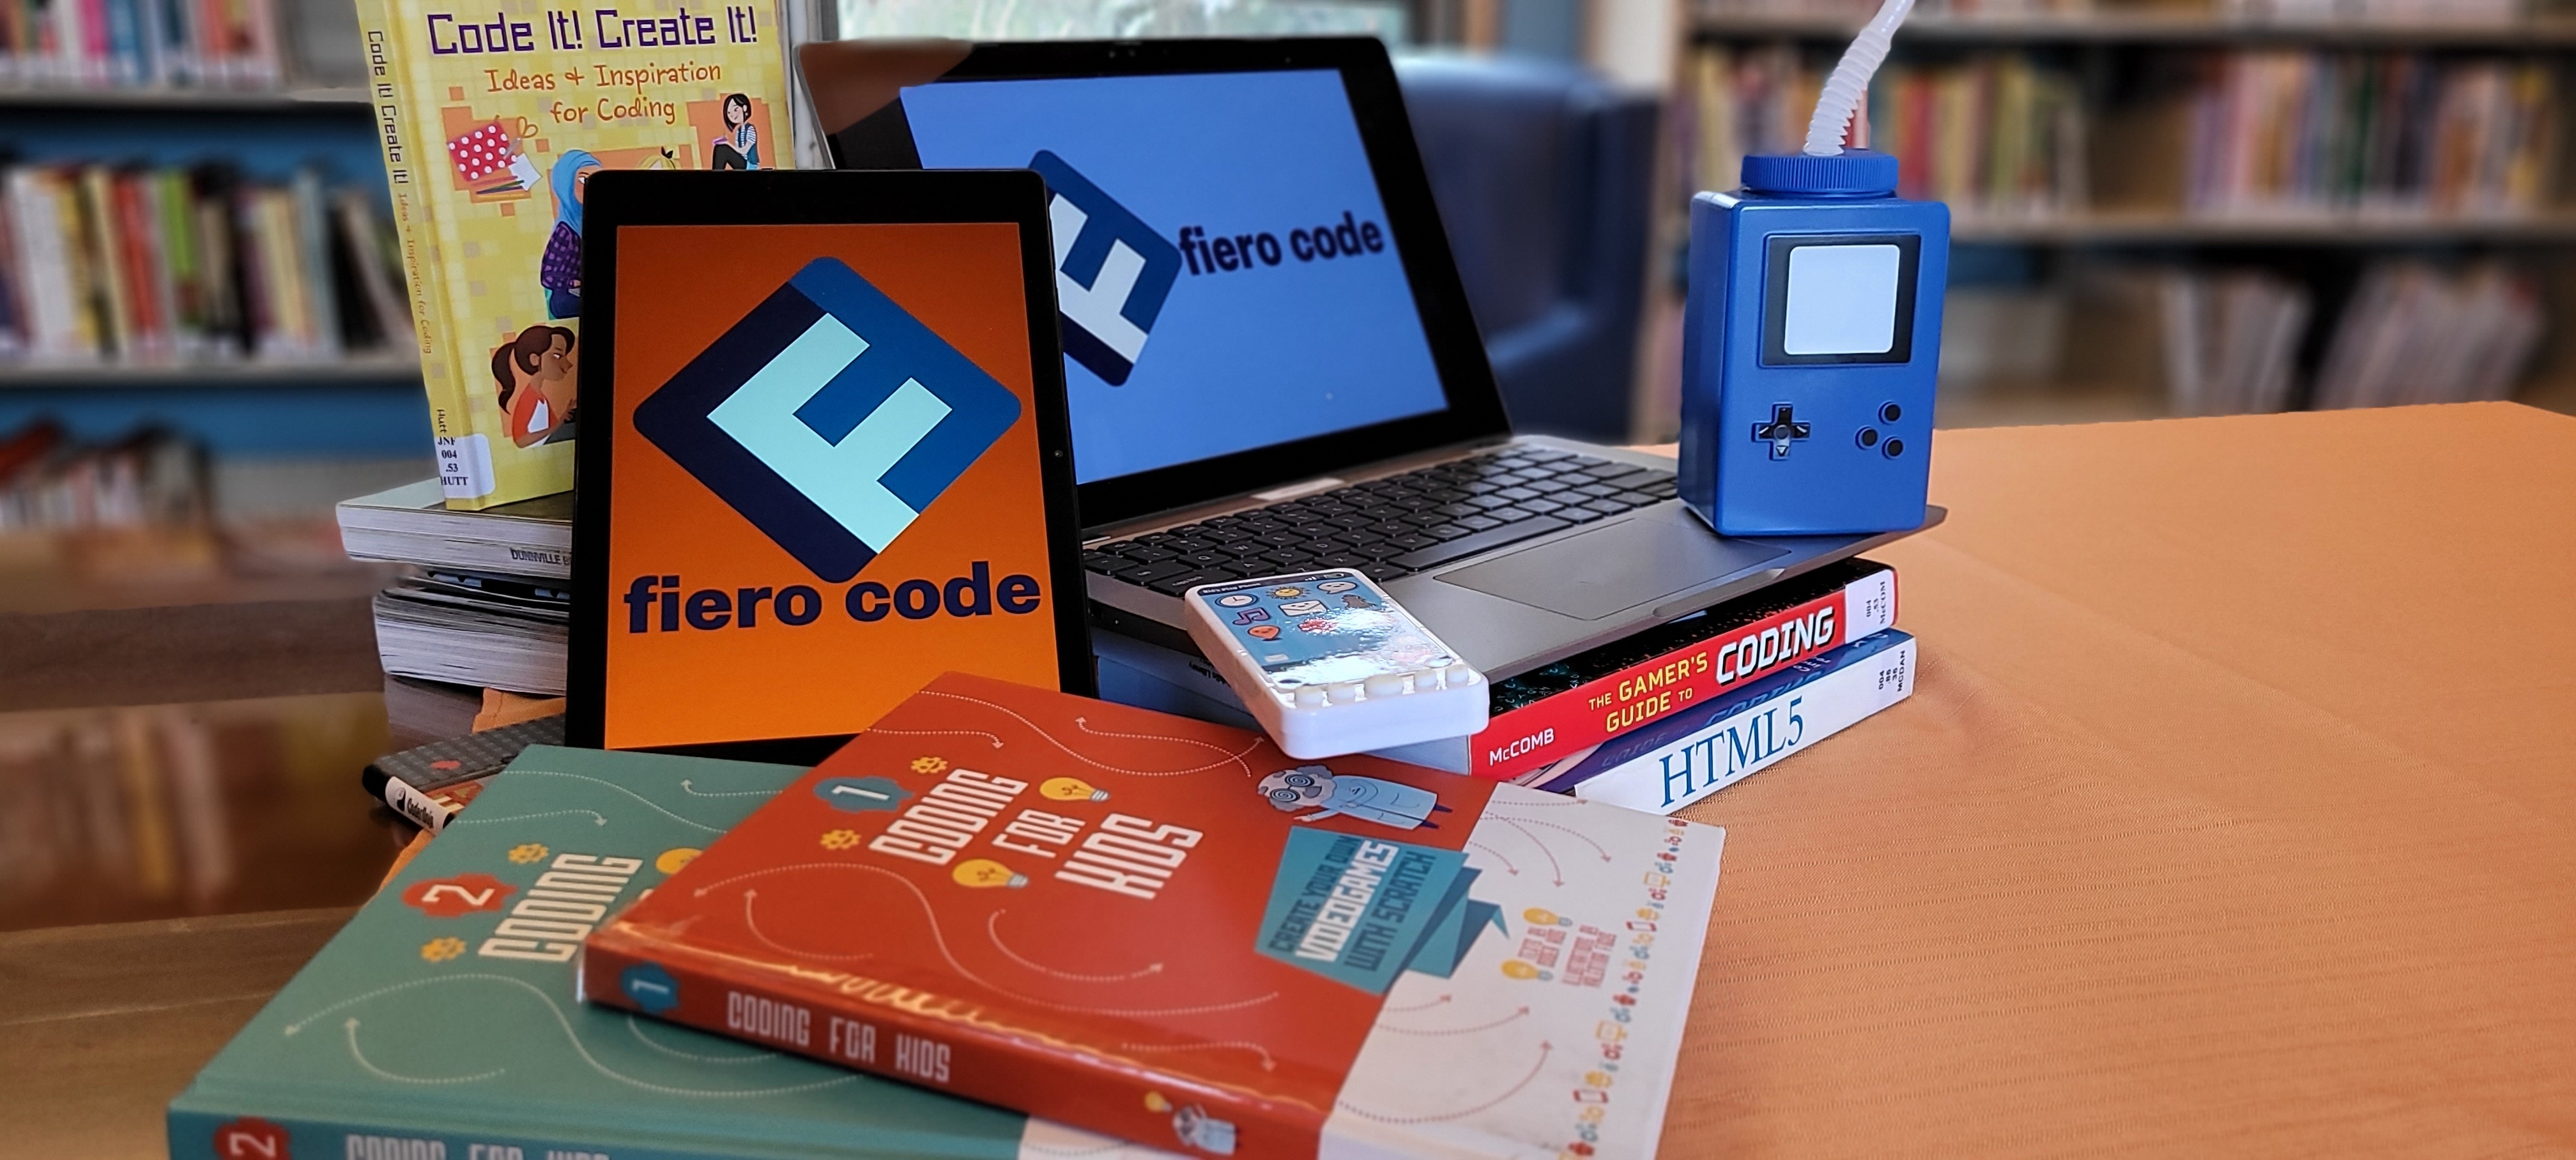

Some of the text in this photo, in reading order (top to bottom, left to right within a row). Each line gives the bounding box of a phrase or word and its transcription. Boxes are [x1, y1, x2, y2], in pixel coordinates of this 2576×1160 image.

[427, 6, 758, 54] Code It! Create It!
[368, 31, 409, 183] Code It! Create It!
[484, 68, 556, 92] Ideas
[594, 61, 721, 94] Inspiration
[550, 96, 675, 123] for Coding
[1179, 210, 1384, 276] fiero code
[407, 240, 422, 296] Inspiration
[421, 319, 433, 355] Coding
[436, 409, 447, 434] Hutt
[441, 450, 457, 459] 004
[445, 463, 459, 473] .53
[624, 575, 822, 634] fiero
[845, 561, 1041, 622] code
[1715, 606, 1836, 687] CODING
[1588, 694, 1613, 711] THE
[1619, 652, 1708, 702] GAMER'S
[1606, 692, 1671, 733] GUIDE
[1678, 687, 1692, 702] TO
[1489, 728, 1554, 767] McCOMB
[1659, 695, 1804, 809] HTML5
[868, 768, 1029, 866] CODING
[992, 808, 1086, 859] FOR
[1054, 813, 1203, 899] KIDS
[421, 884, 494, 906] 2
[477, 853, 643, 962] CODING
[1268, 835, 1361, 952] CREATE YOUR OWN
[1294, 839, 1399, 963] VIDEOGAMES
[1344, 851, 1436, 972] WITH SCRATCH
[727, 991, 951, 1083] CODING FOR KIDS
